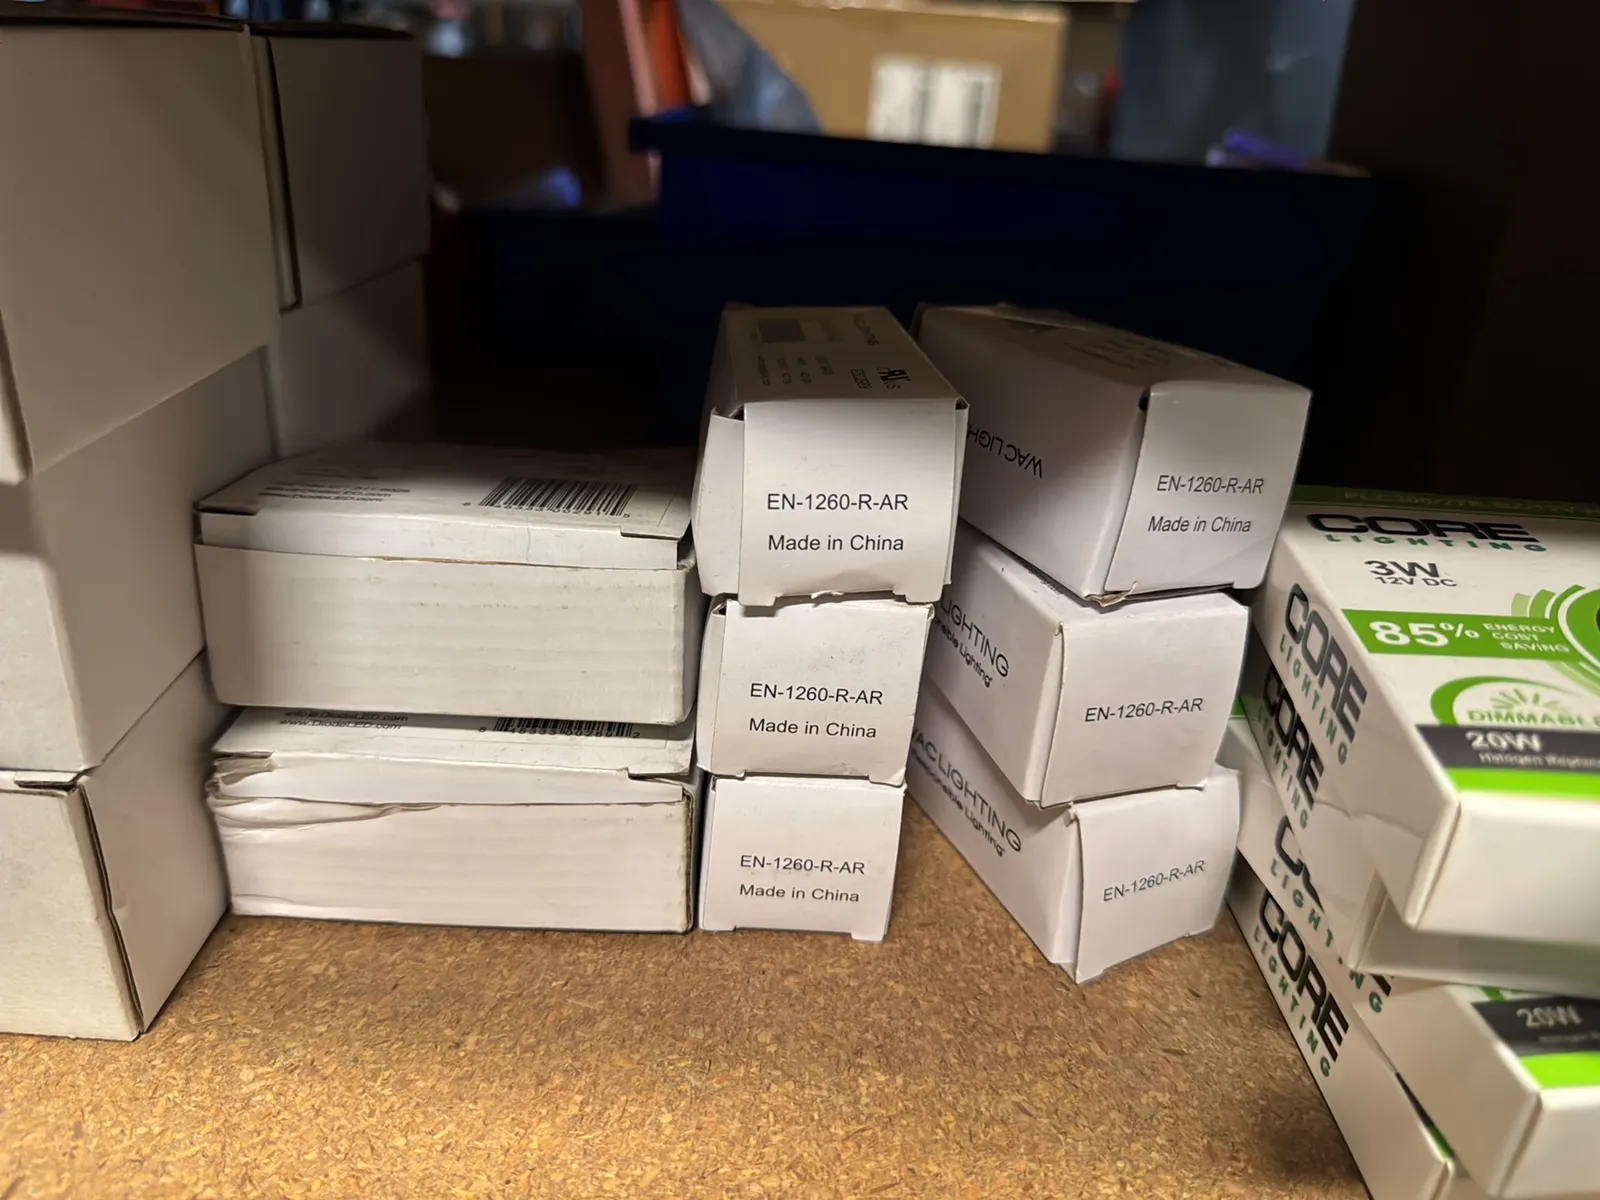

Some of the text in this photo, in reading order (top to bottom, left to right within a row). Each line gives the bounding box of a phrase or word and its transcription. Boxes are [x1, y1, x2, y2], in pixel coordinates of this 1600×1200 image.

[1156, 474, 1265, 496] EN-1260-R-AR
[766, 493, 909, 511] EN-1260-R-AR
[1147, 516, 1252, 534] Made in China
[1306, 513, 1540, 543] CORE
[768, 534, 904, 551] Made in China
[1325, 534, 1548, 553] LIGHTING
[1364, 560, 1440, 579] 3W
[1376, 576, 1458, 588] 12V DC
[1368, 620, 1480, 648] 85%
[1482, 622, 1556, 635] ENERGY
[1492, 631, 1540, 642] COST
[1500, 641, 1571, 654] SAVING
[1285, 583, 1368, 744] CORE
[749, 682, 884, 705] EN-1260-R-AR
[1279, 633, 1349, 766] LIGHTING
[1084, 698, 1204, 722] EN-1260-R-AR
[279, 719, 402, 730] www.DiodeLED.com
[749, 717, 877, 738] Made in China
[1263, 664, 1325, 811] CORE
[1465, 730, 1543, 753] 20W
[739, 854, 866, 875] EN-1260-R-AR
[1103, 859, 1206, 902] EN-1260-R-AR
[739, 883, 860, 902] Made in China
[1270, 858, 1384, 1014] LIGHTNG
[1259, 888, 1350, 1063] CORE
[1254, 924, 1332, 1078] LIGHTING
[1516, 1006, 1584, 1028] 20W
